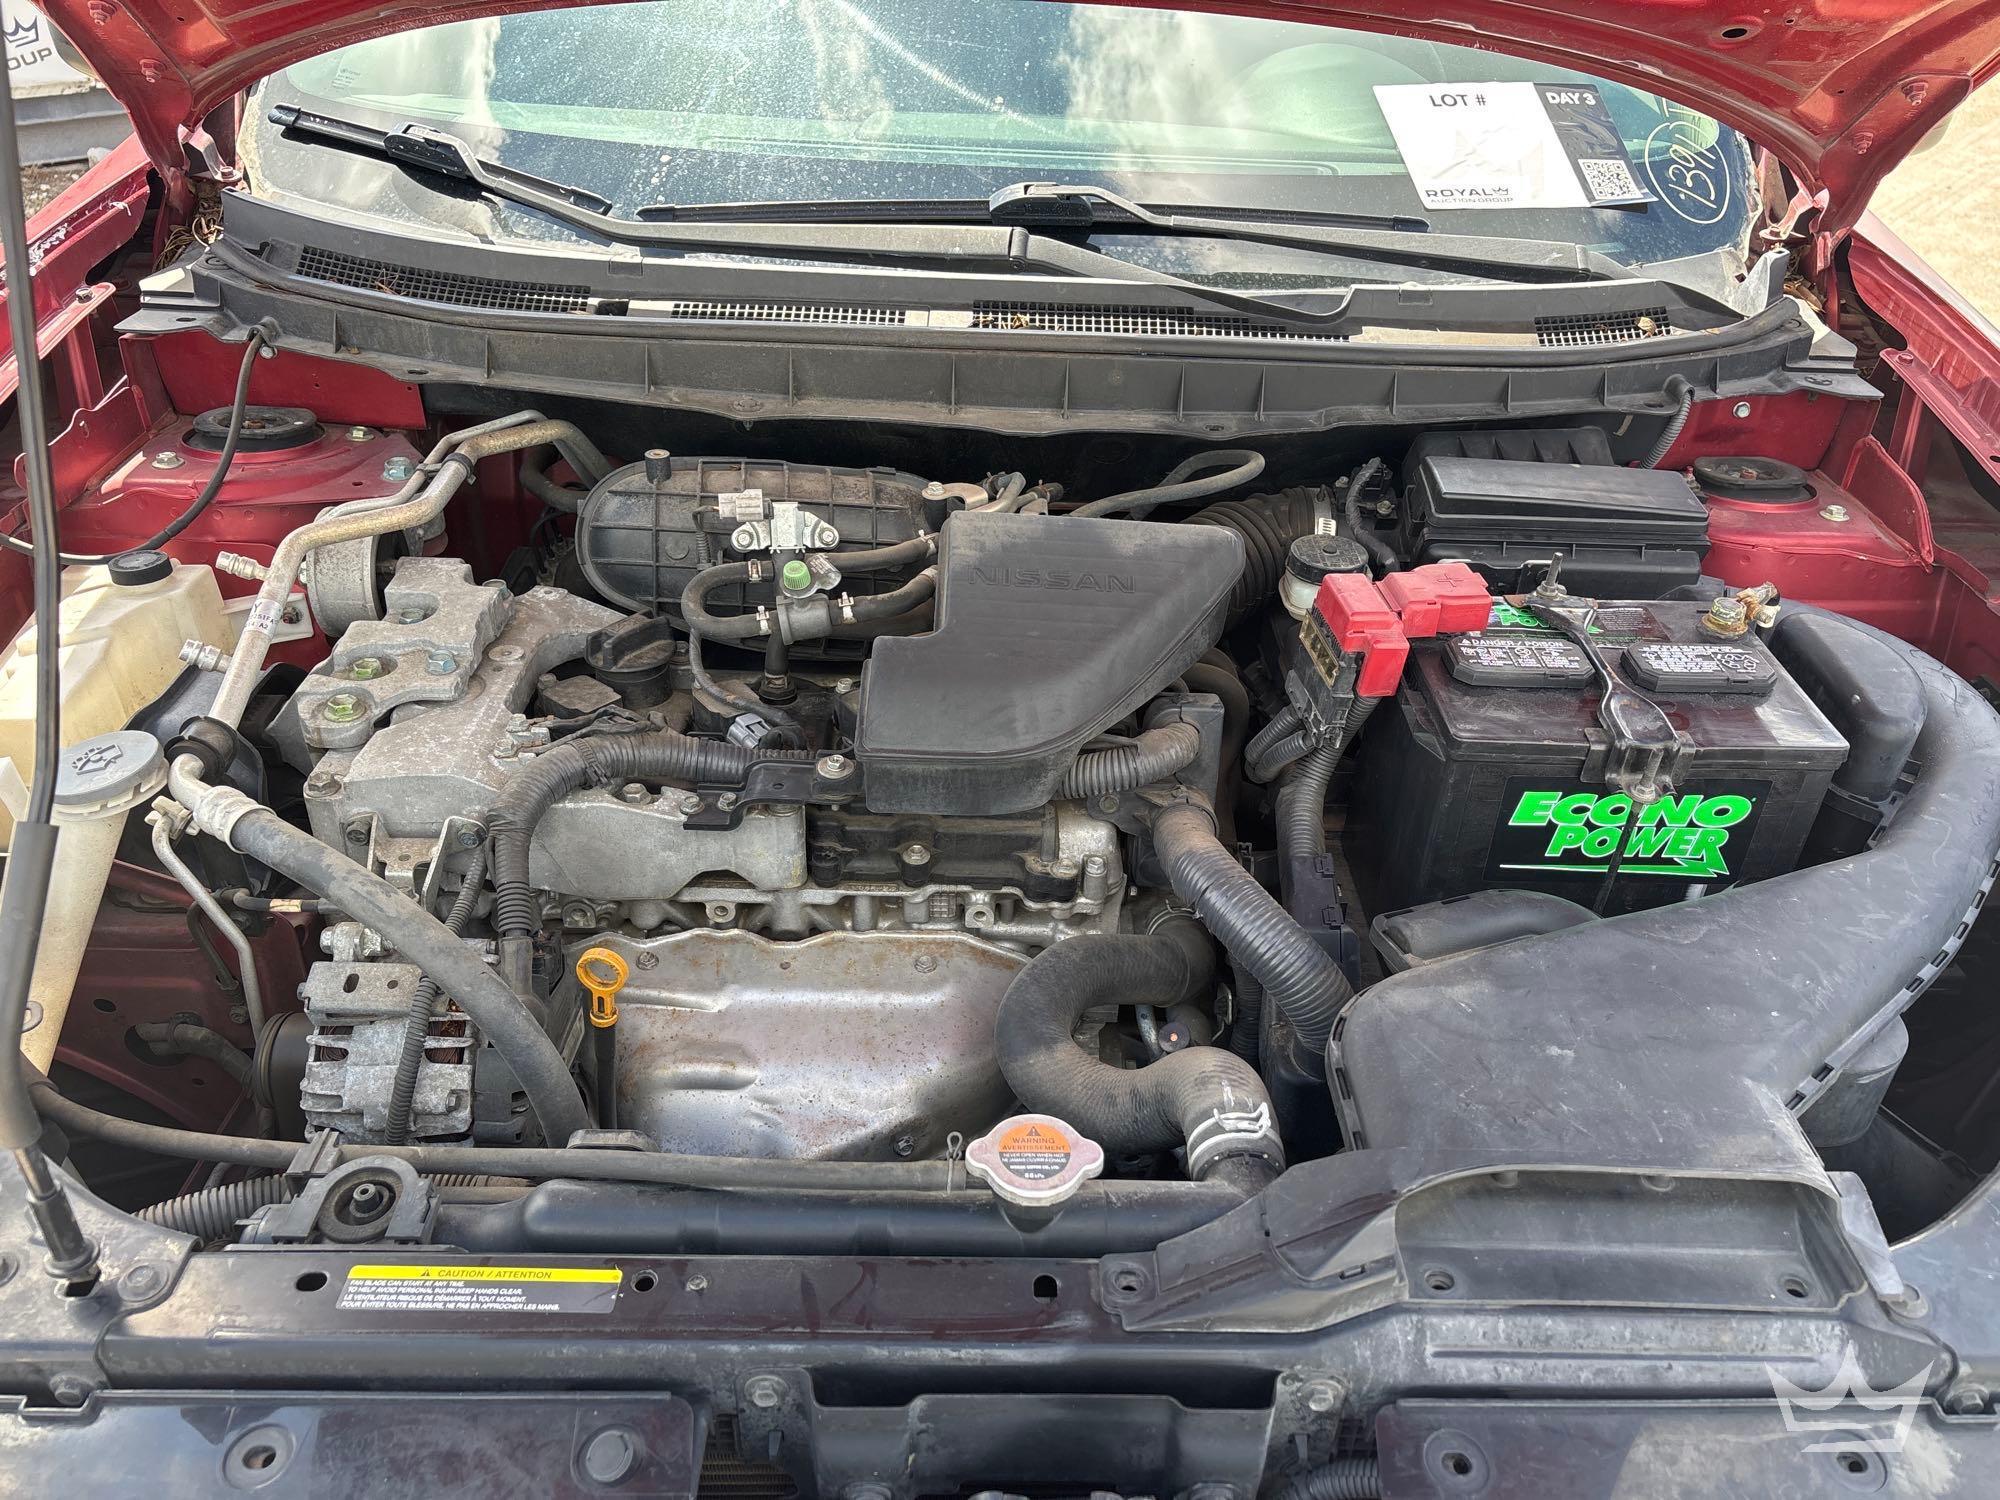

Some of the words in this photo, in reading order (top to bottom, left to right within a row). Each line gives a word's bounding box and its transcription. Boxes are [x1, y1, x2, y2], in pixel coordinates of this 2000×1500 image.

[1430, 94, 1471, 107] LOT
[1475, 93, 1487, 106] #
[1545, 92, 1583, 105] DAY
[1583, 93, 1596, 106] 3
[1425, 188, 1493, 197] ROYAL
[967, 566, 1136, 594] NISSAN
[1471, 639, 1515, 647] DANGER
[1525, 640, 1564, 648] POISON
[1508, 791, 1752, 828] ECONO
[1545, 825, 1729, 875] POWER
[437, 1269, 485, 1277] CAUTION
[495, 1270, 553, 1279] ATTENTION
[340, 1300, 362, 1308] POUR
